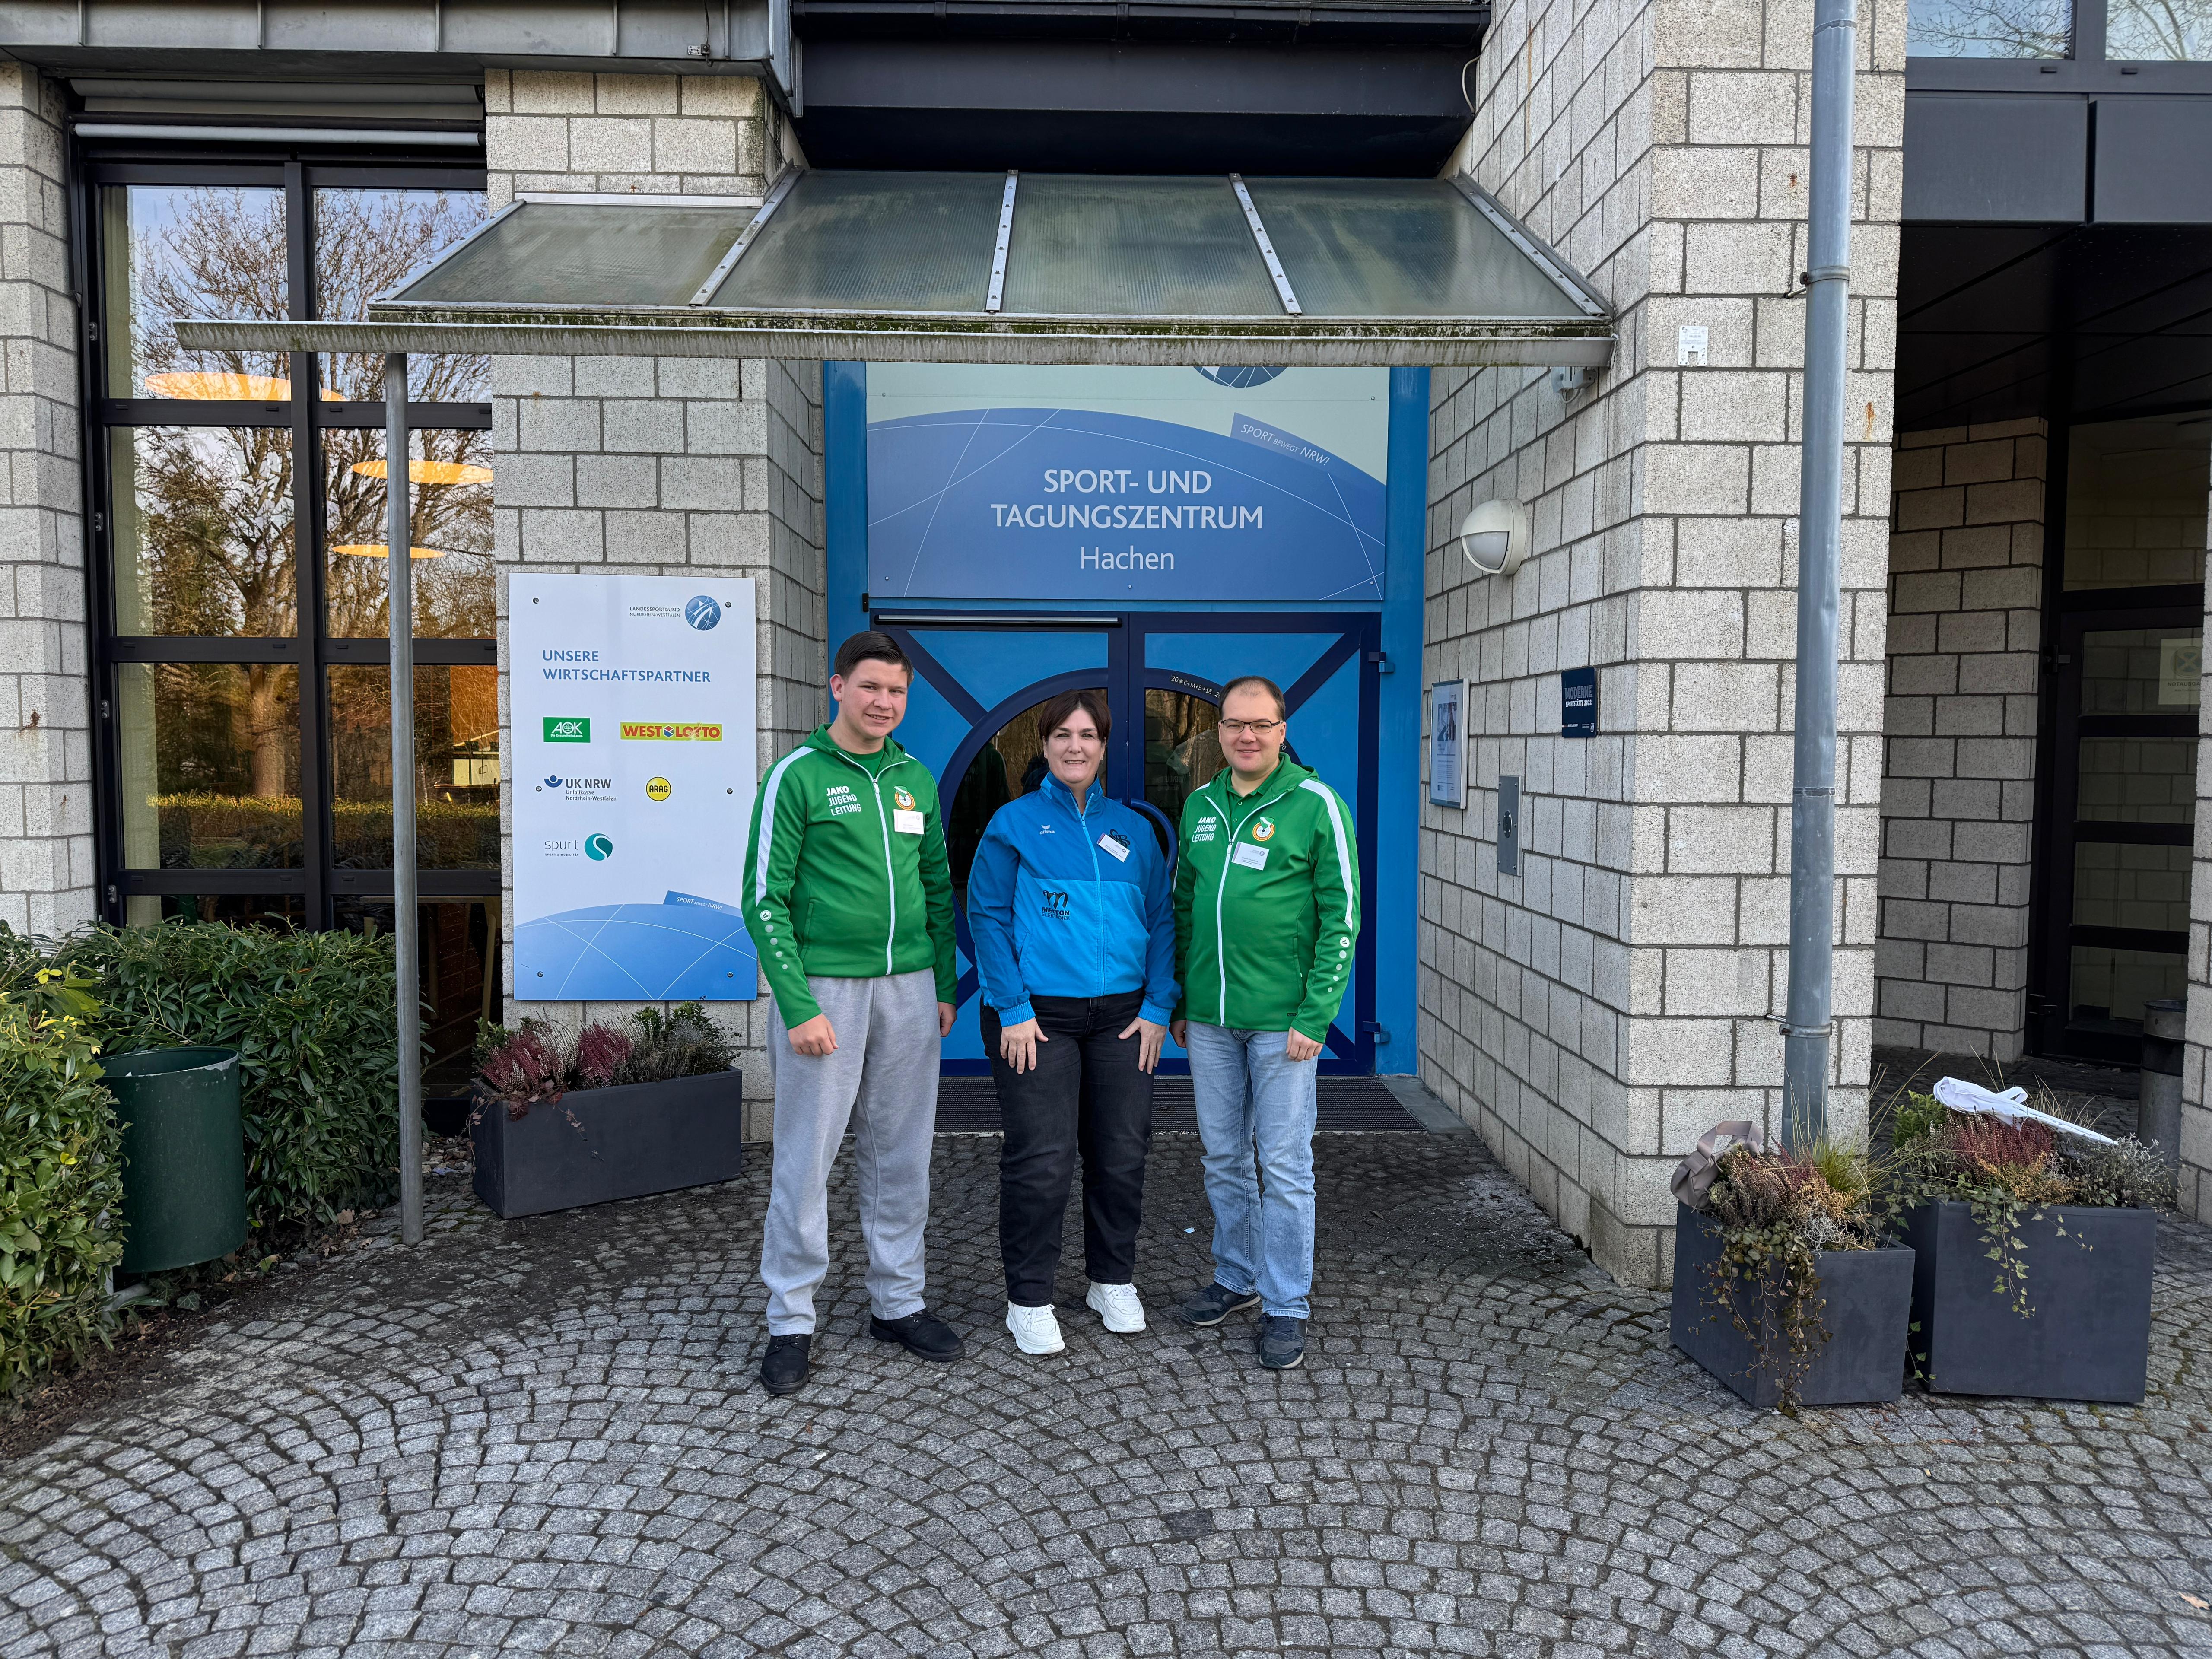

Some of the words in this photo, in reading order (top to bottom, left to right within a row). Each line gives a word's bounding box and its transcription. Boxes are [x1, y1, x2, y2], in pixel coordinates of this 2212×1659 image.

[1240, 424, 1275, 442] SPORT
[1273, 438, 1300, 453] BEWEGT
[1300, 446, 1331, 466] NRW!
[1043, 469, 1139, 493] SPORT-
[1148, 470, 1212, 494] UND
[990, 503, 1263, 529] TAGUNGSZENTRUM
[1080, 545, 1175, 570] Hachen
[542, 649, 599, 662] UNSERE
[542, 668, 711, 683] WIRTSCHAFTSPARTNER
[1564, 685, 1592, 699] MODERNE
[551, 721, 583, 734] AOK
[566, 778, 582, 789] UK
[585, 779, 612, 789] NRW
[826, 785, 850, 796] JAKO
[828, 794, 858, 807] JUGEND
[830, 803, 862, 816] LEITUNG
[1197, 816, 1217, 824] JAKO
[1194, 824, 1217, 833] JUGEND
[1192, 833, 1215, 843] LEITUNG
[544, 839, 579, 852] spurt
